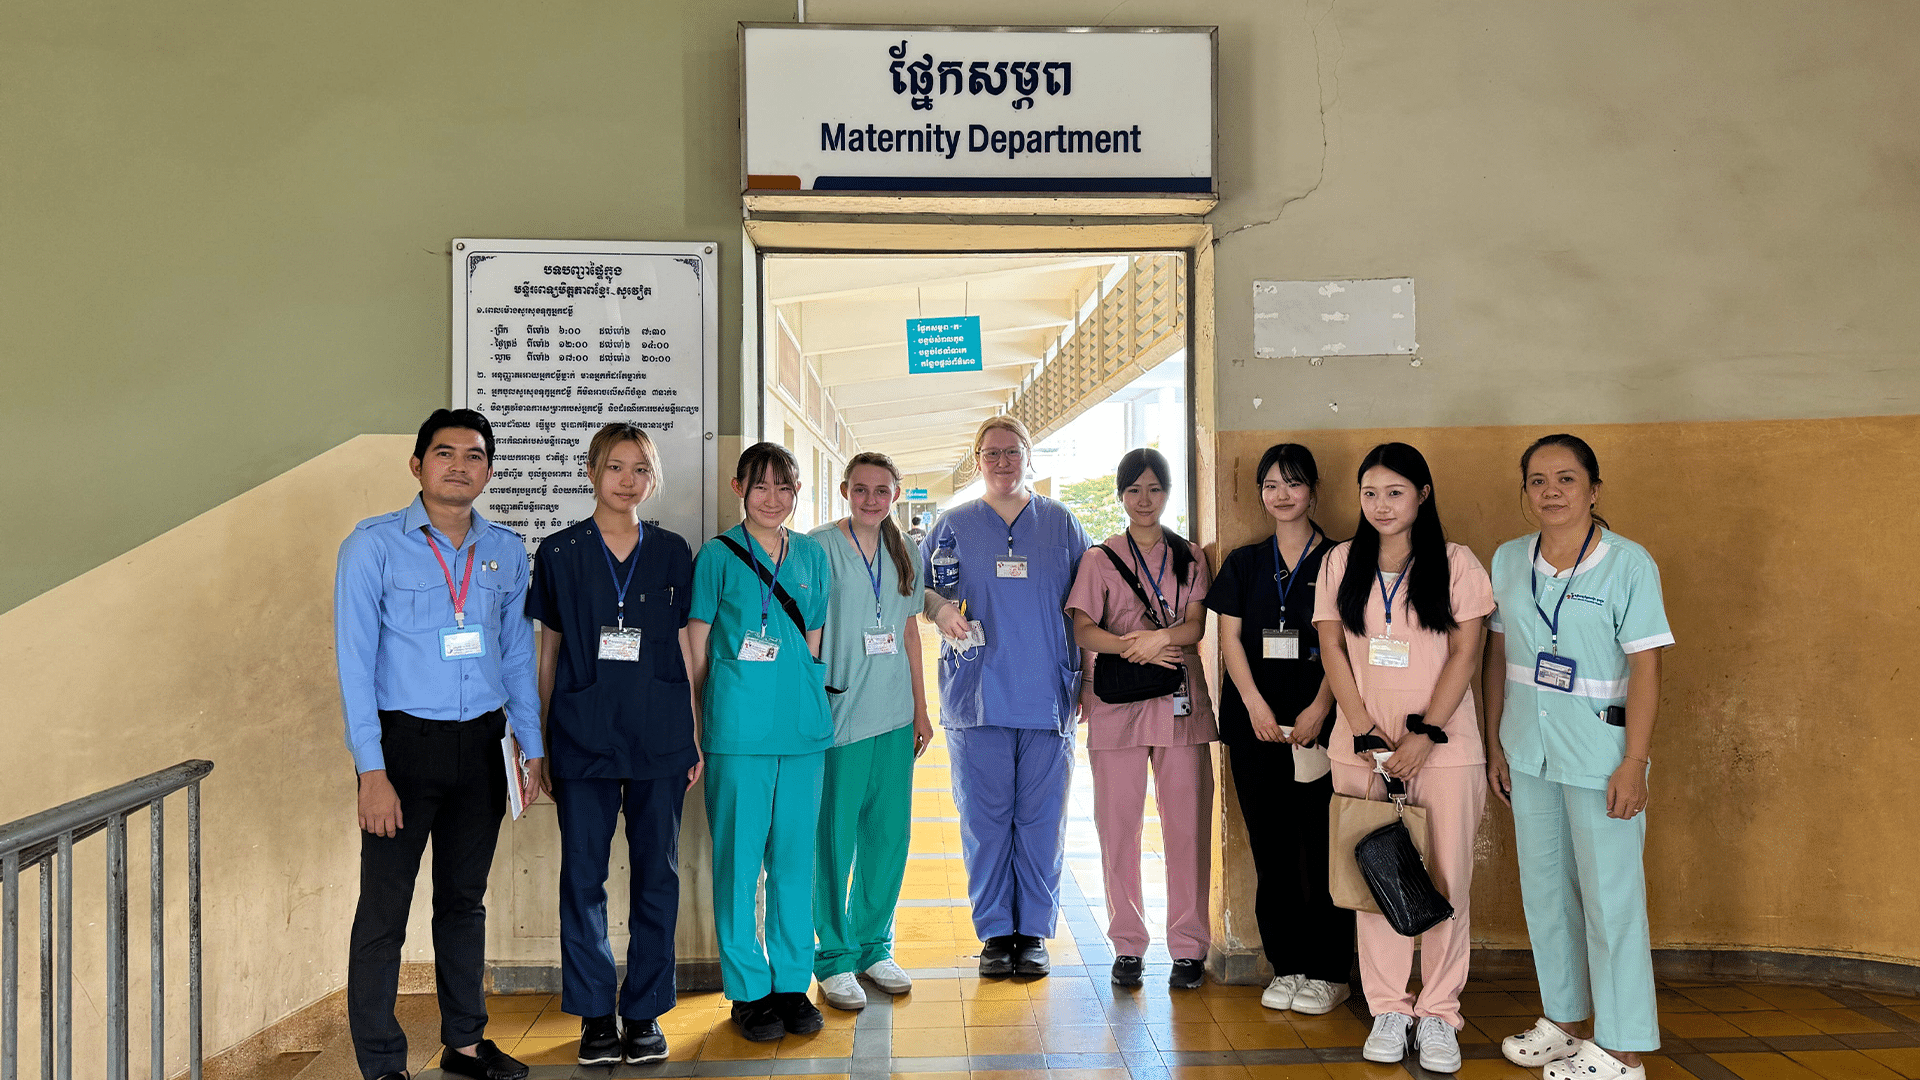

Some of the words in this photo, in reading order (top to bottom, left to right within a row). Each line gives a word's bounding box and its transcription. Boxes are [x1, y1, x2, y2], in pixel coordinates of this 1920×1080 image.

[889, 40, 1073, 110] ផ្នែកសម្ភព
[820, 122, 960, 159] Maternity
[968, 124, 1142, 159] Department
[543, 261, 623, 284] បទបញ្ជាផ្ទៃក្នុង
